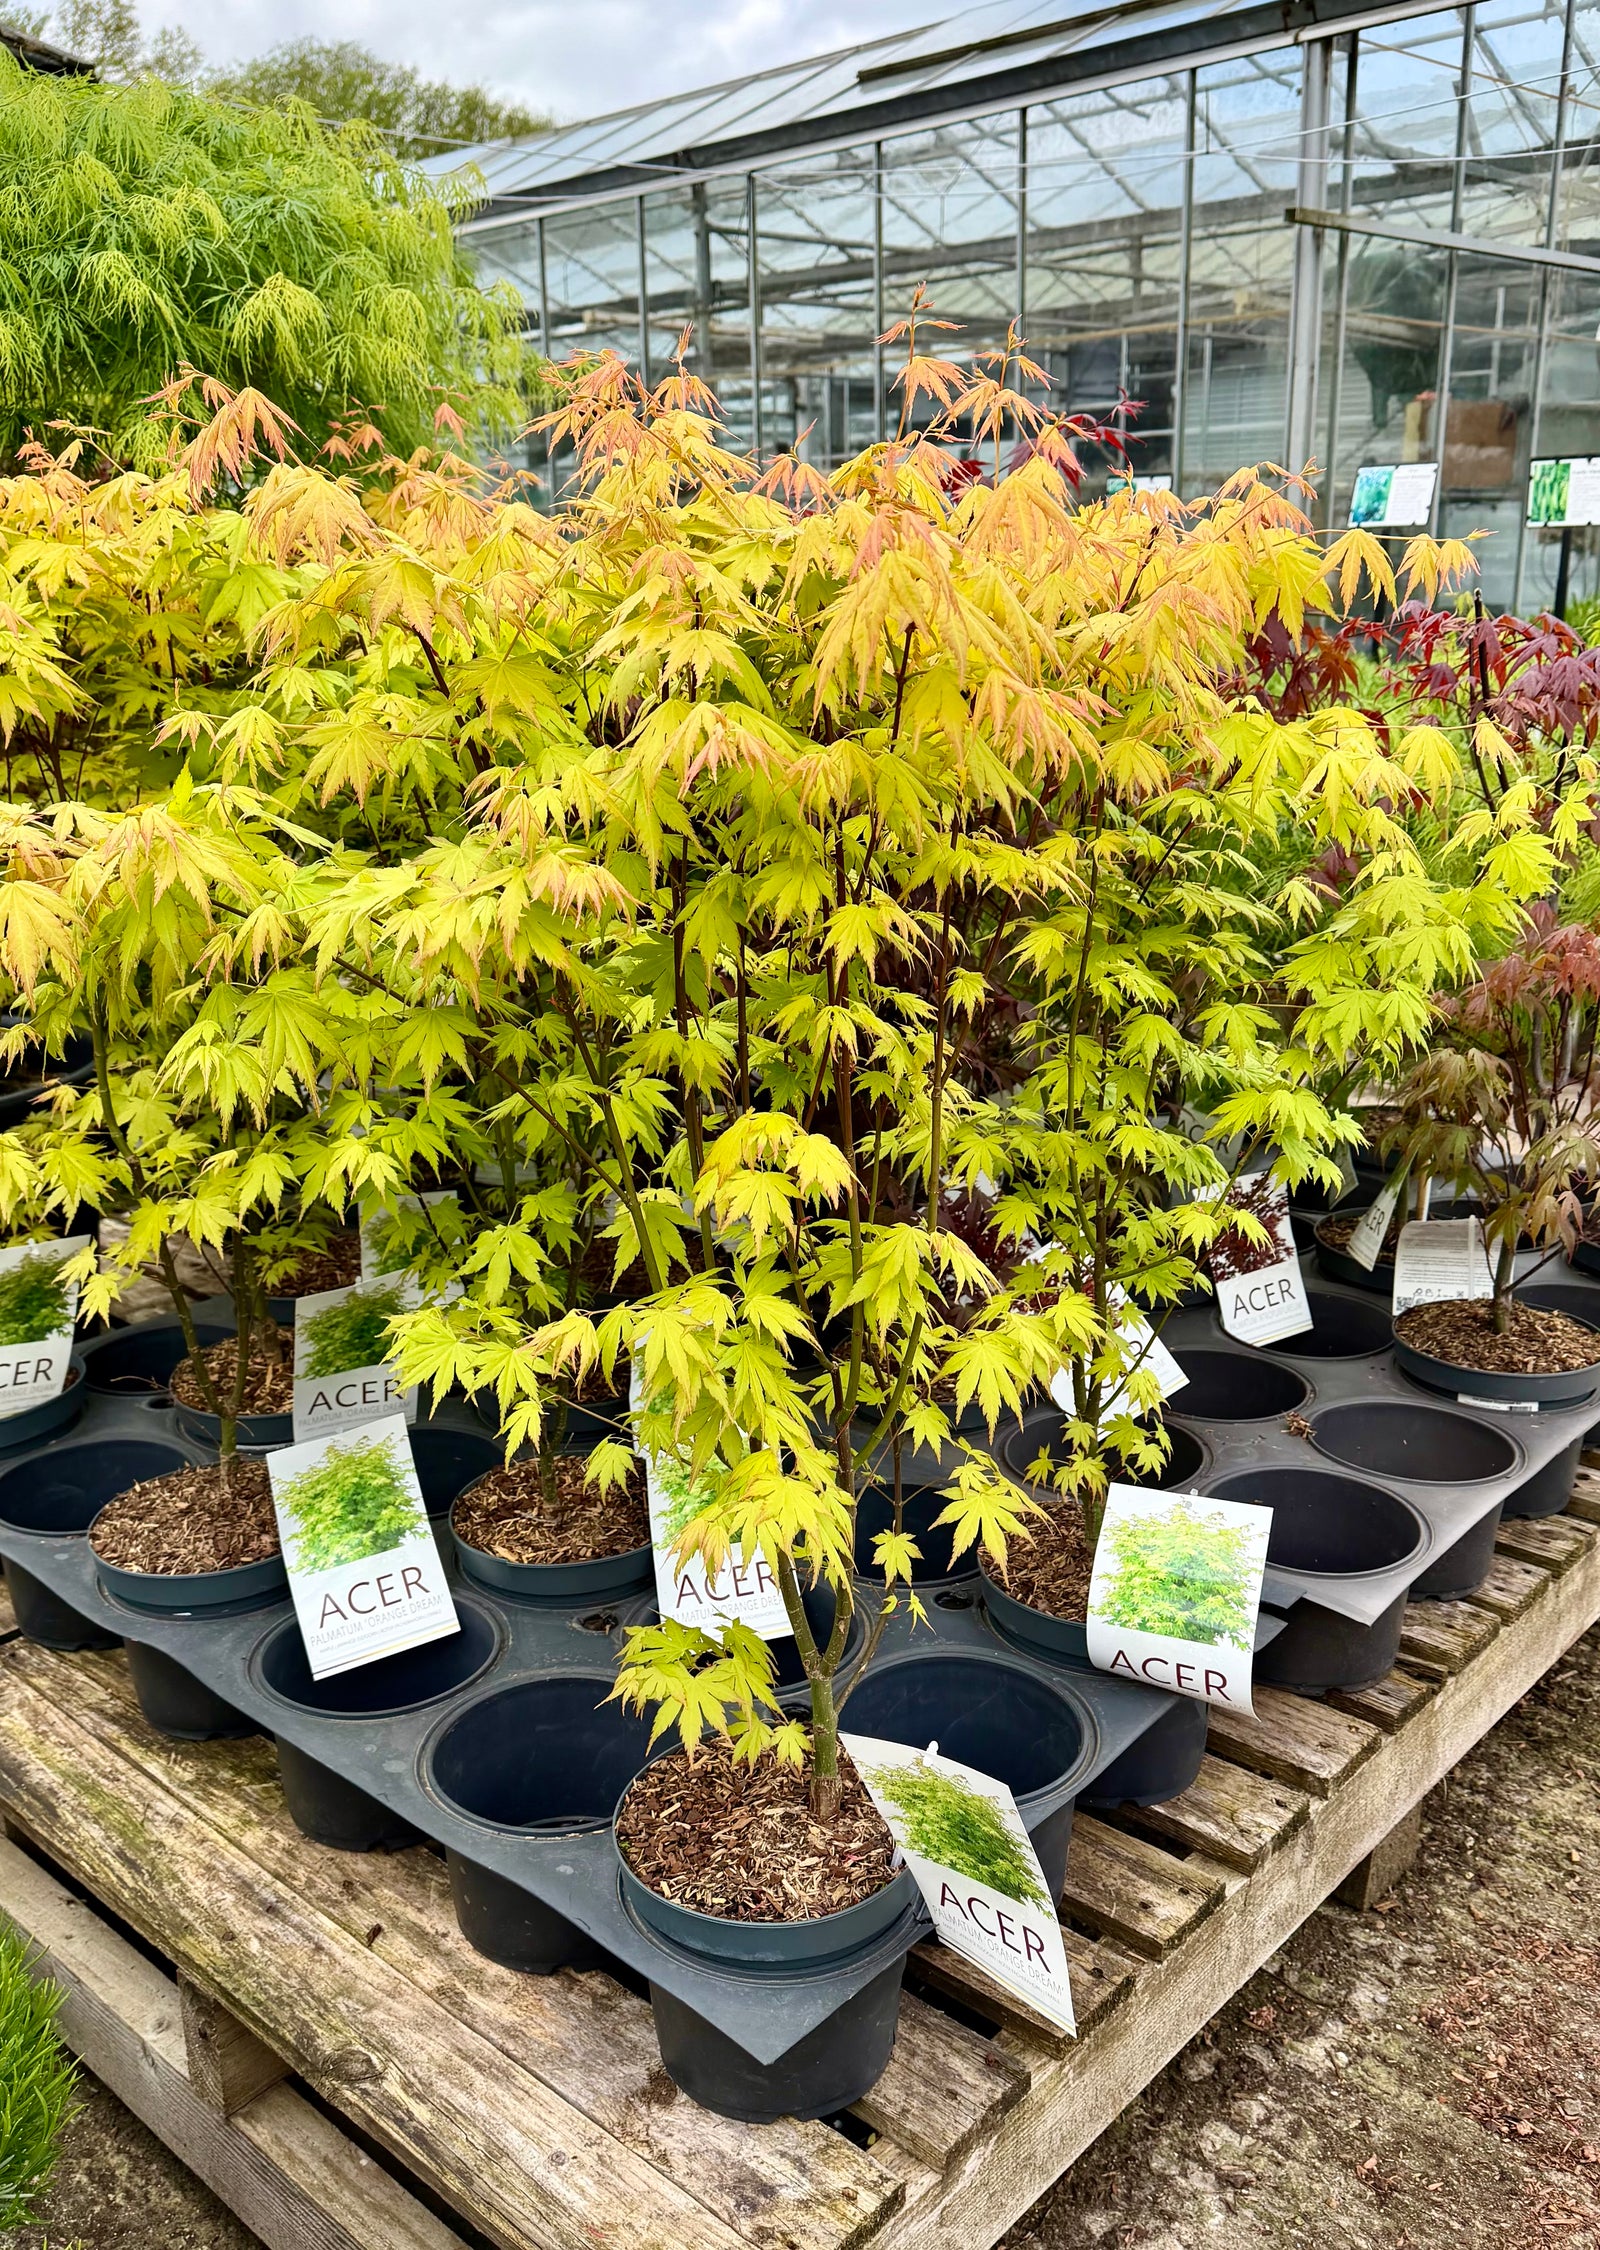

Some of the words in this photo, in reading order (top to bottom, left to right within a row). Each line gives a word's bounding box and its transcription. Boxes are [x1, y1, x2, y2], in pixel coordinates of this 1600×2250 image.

[1177, 1119, 1230, 1154] ACR
[1233, 1278, 1296, 1319] ACER
[307, 1379, 404, 1415] ACER
[319, 1566, 431, 1629] ACER
[310, 1622, 364, 1647] PALMATUM
[1109, 1649, 1232, 1702] ACER
[932, 1904, 983, 1943] PALMATUM
[940, 1882, 1052, 1974] ACER
